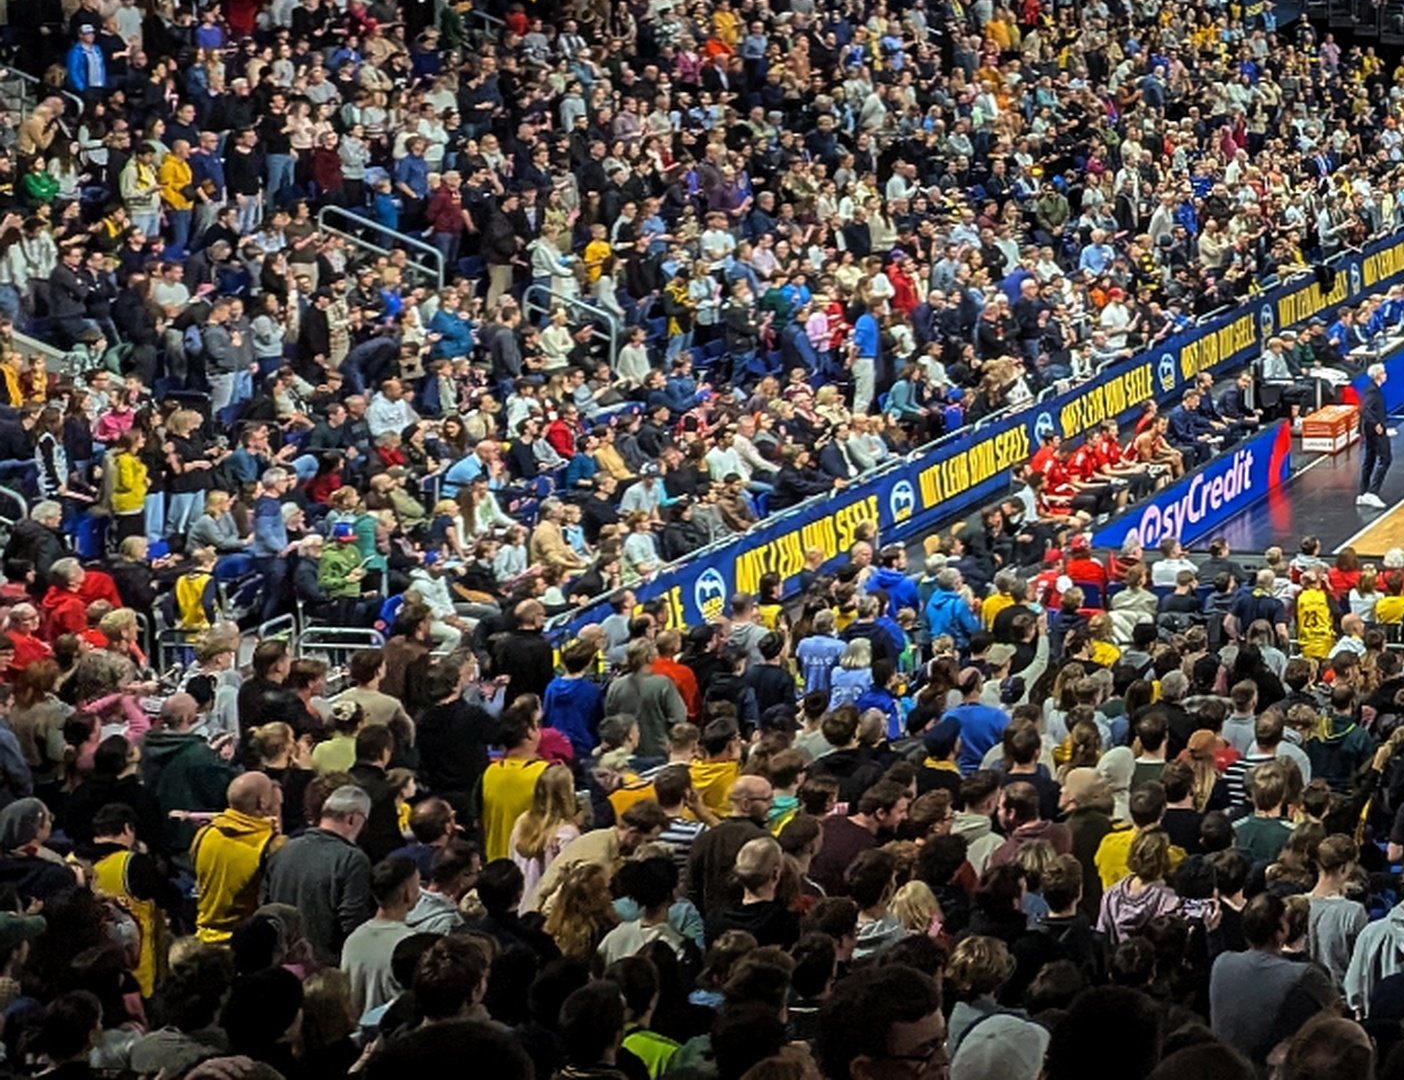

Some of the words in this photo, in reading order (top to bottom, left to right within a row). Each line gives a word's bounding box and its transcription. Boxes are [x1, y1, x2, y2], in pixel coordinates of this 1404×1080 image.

[1060, 404, 1083, 439] MIT
[1125, 362, 1154, 408] SEELE
[918, 466, 945, 509] MIT
[942, 452, 971, 499] LEIB
[968, 440, 996, 485] UND
[993, 423, 1030, 471] SEELE
[735, 548, 770, 596] MIT
[1303, 609, 1320, 629] 23
